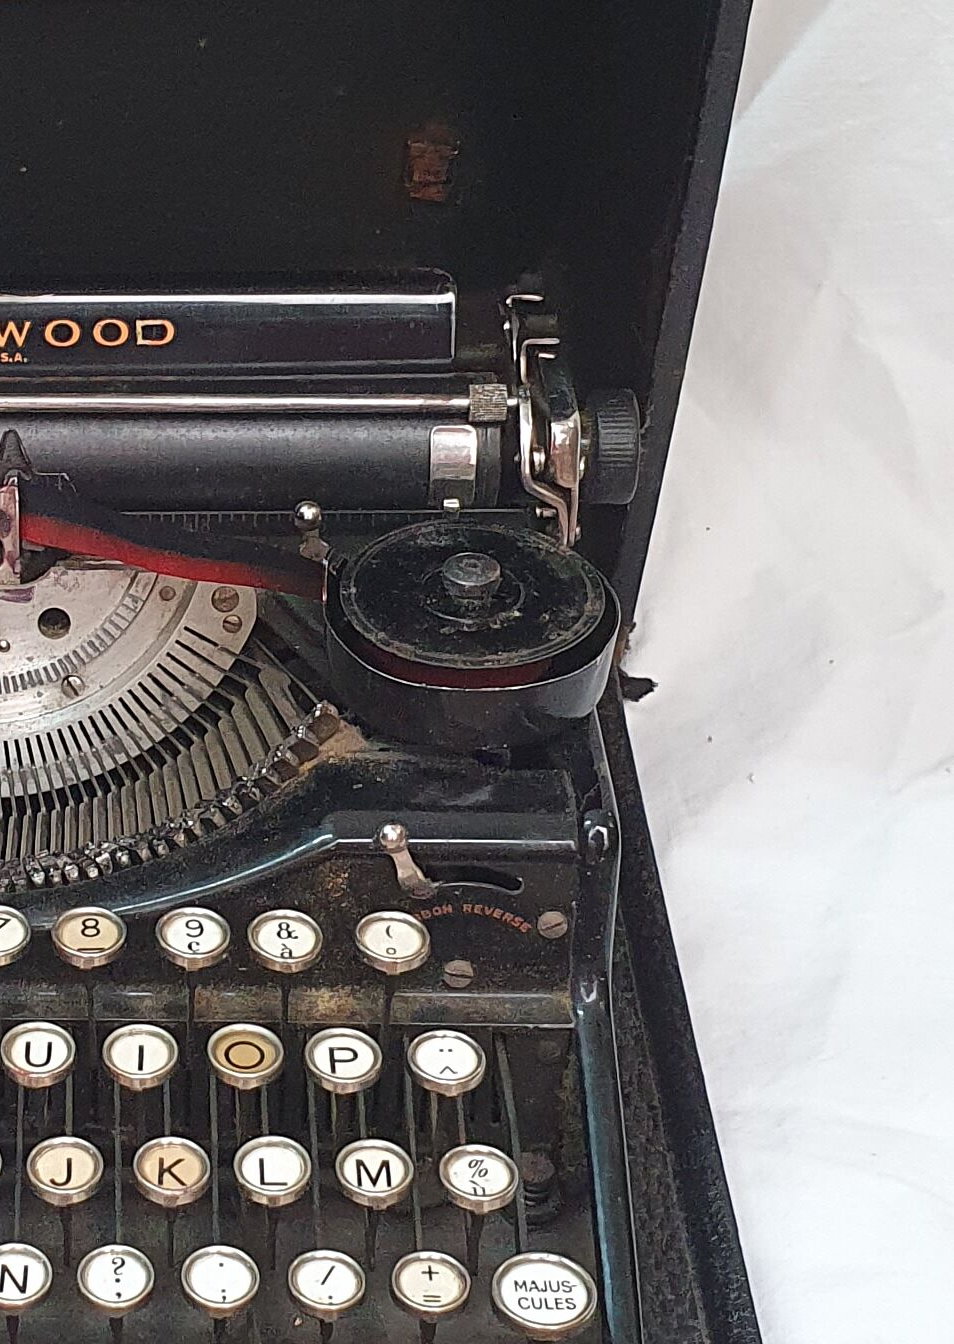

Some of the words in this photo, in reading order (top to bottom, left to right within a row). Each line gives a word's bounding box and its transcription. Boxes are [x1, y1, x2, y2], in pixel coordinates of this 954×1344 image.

[81, 918, 101, 938] 8
[185, 919, 204, 938] 9
[276, 921, 298, 940] &
[461, 903, 532, 934] REVERSE
[24, 1041, 53, 1068] U
[137, 1044, 145, 1071] I
[224, 1040, 265, 1070] O
[329, 1046, 360, 1075] P
[49, 1157, 73, 1187] J
[157, 1157, 188, 1186] K
[259, 1158, 288, 1186] L
[356, 1159, 393, 1188] M
[468, 1159, 489, 1179] %
[111, 1257, 126, 1284] ?
[321, 1265, 336, 1285] /
[421, 1265, 439, 1282] +
[514, 1279, 578, 1294] MAJUS-
[517, 1296, 578, 1311] CULES
